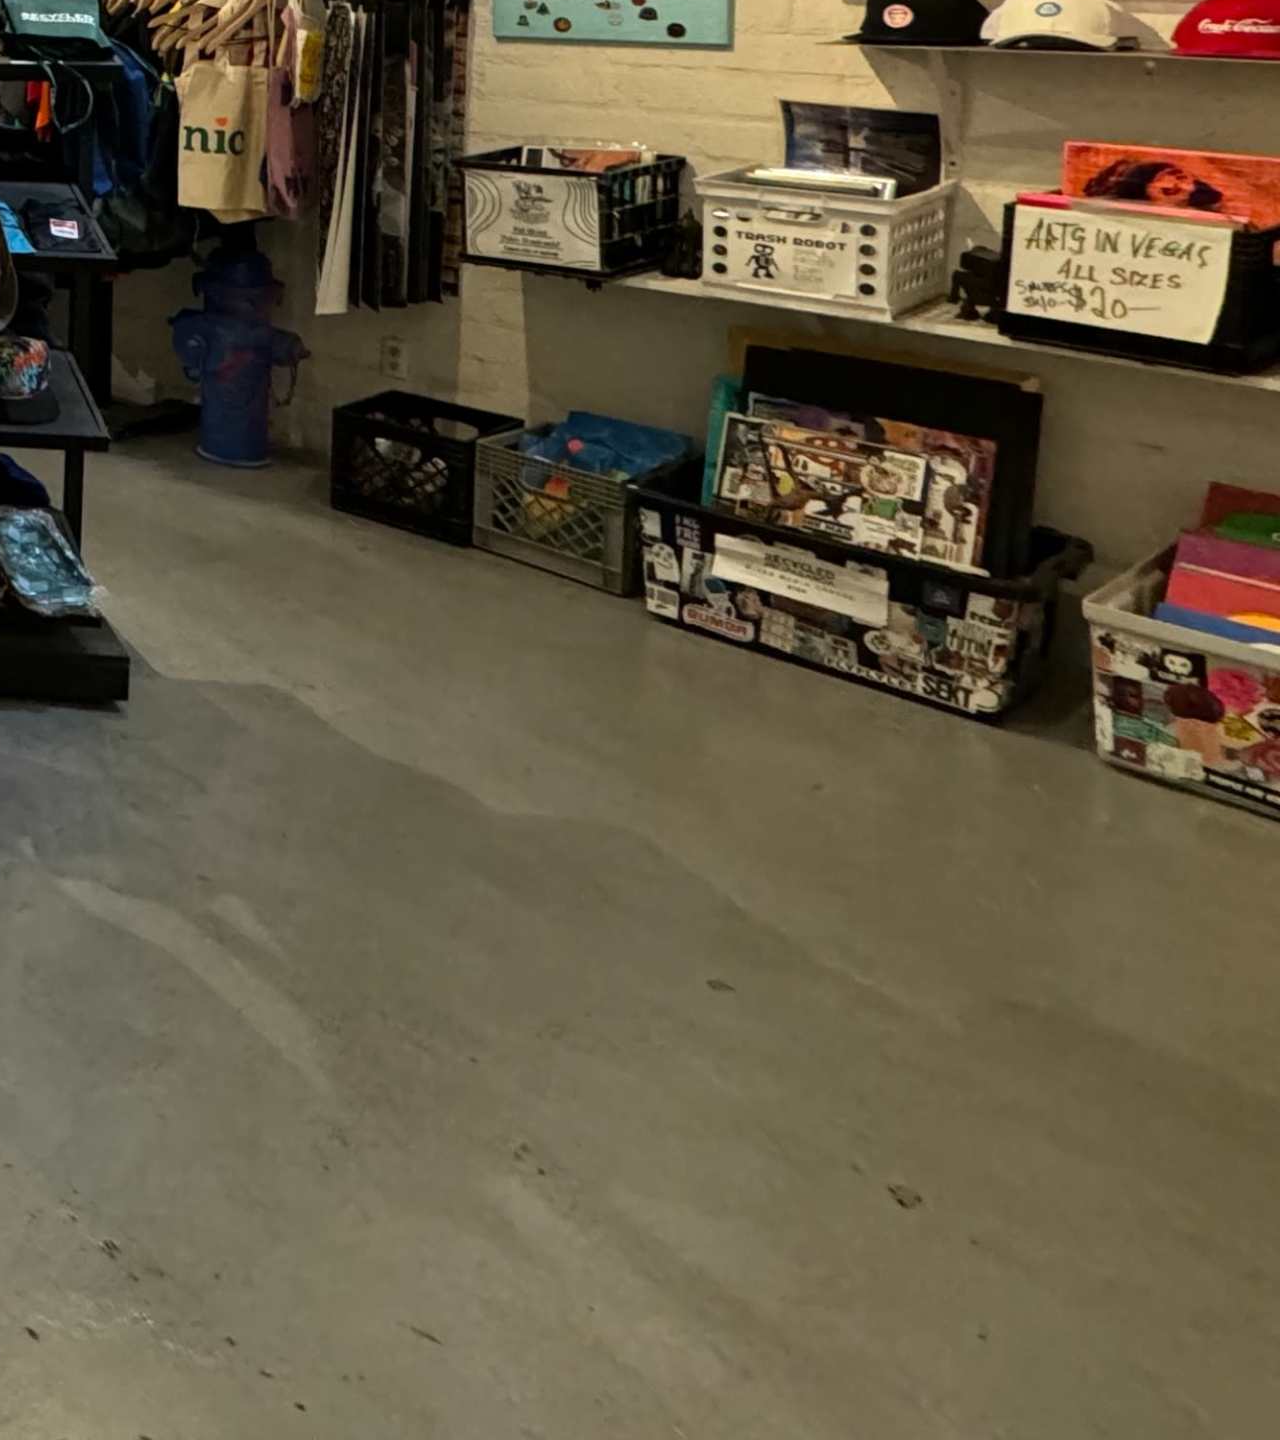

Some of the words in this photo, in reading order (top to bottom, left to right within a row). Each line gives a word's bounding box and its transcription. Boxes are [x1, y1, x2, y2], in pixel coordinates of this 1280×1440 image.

[736, 230, 787, 244] TRASH
[792, 237, 847, 251] ROBOT
[1024, 218, 1086, 255] ARTS
[1095, 228, 1121, 254] IN
[1130, 232, 1212, 268] VEGAS
[1057, 258, 1100, 283] ALL
[1110, 267, 1183, 290] SIZES
